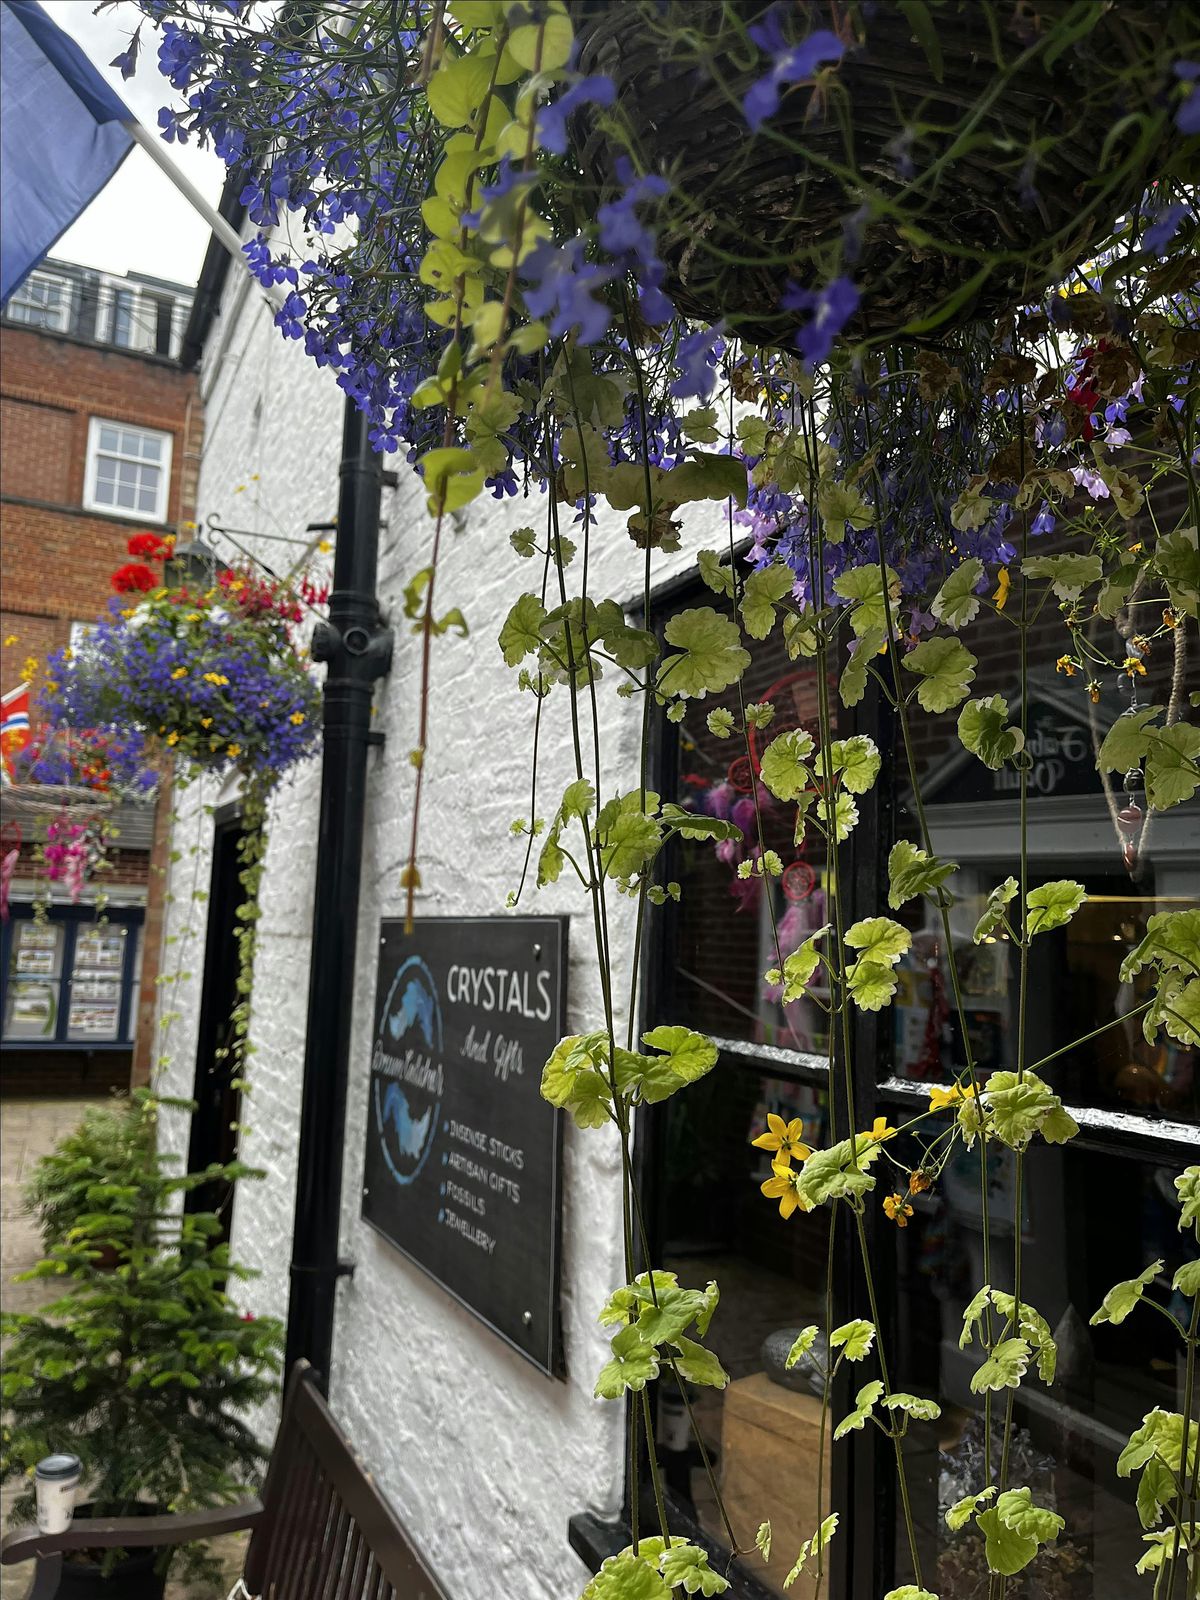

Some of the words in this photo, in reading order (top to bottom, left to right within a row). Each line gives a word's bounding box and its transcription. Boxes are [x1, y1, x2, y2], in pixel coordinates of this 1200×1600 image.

[447, 964, 551, 1021] CRYSTALS
[460, 1025, 491, 1063] And
[493, 1034, 524, 1081] Gifts
[448, 1151, 488, 1184] ARTISAN
[488, 1172, 520, 1204] GIFTS
[488, 1137, 524, 1170] STICKS
[446, 1180, 486, 1216] FOSSILS
[445, 1208, 496, 1256] JEWELLERY
